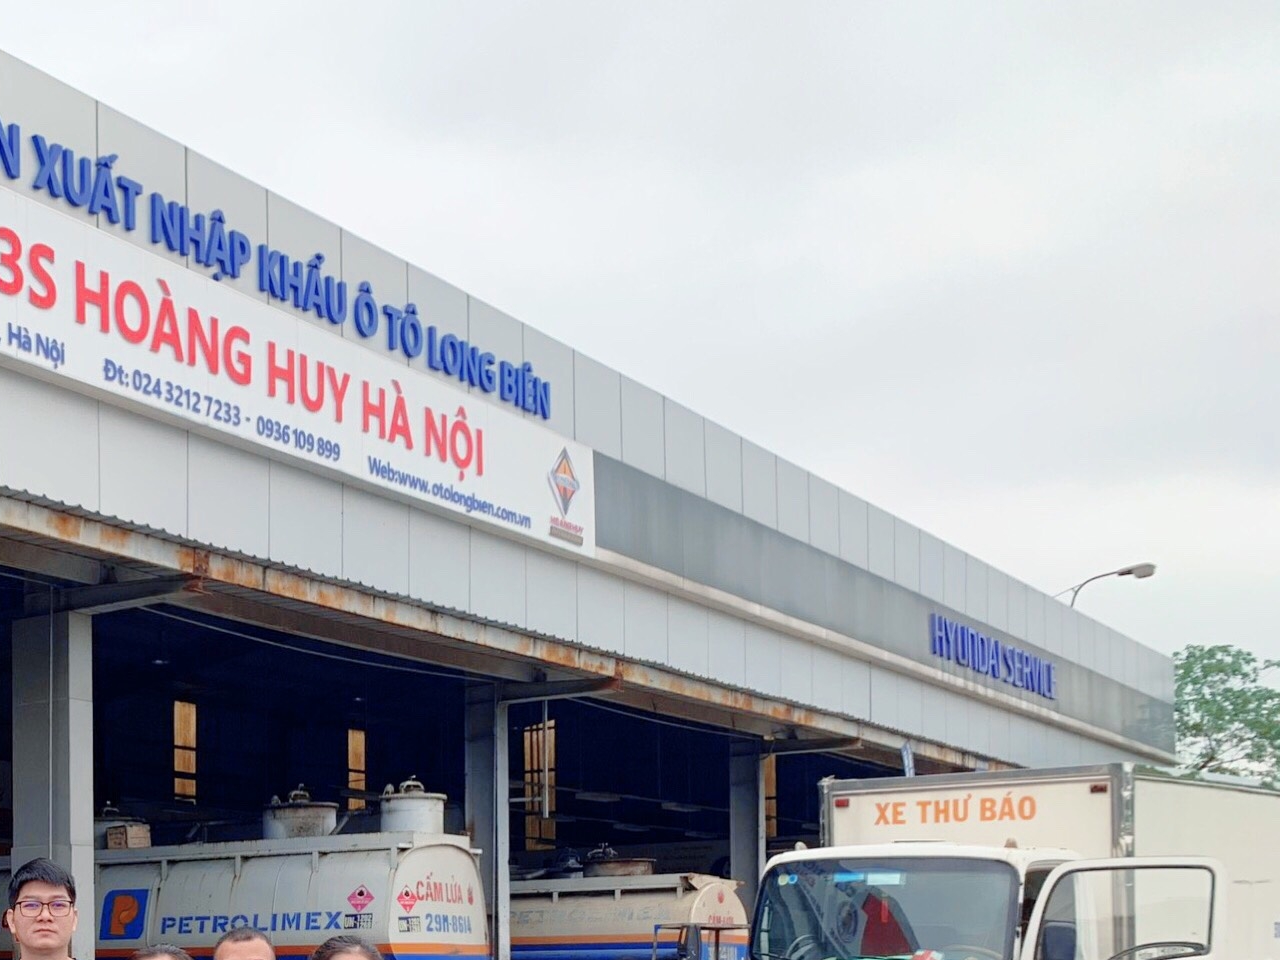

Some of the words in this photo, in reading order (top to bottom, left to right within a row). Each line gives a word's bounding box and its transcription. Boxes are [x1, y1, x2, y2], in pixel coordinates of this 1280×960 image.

[31, 134, 143, 231] XUẤT
[150, 192, 251, 281] NHẬP
[258, 244, 347, 325] KHẨU
[354, 281, 378, 338] Ô
[383, 303, 423, 359] TÔ
[428, 325, 496, 393] LONG
[500, 360, 550, 420] BIÊN
[8, 322, 32, 354] Hà
[36, 333, 65, 369] Nội
[74, 260, 253, 386] HOÀNG
[267, 341, 350, 423] HUY
[362, 379, 413, 450] HÀ
[424, 406, 484, 480] NỘI
[103, 358, 130, 388] Đt:
[132, 369, 162, 399] 024
[165, 381, 201, 414] 3212
[204, 396, 241, 426] 7233
[256, 416, 291, 445] 0936
[293, 428, 314, 452] 109
[316, 437, 341, 462] 899
[874, 802, 906, 825] XE
[916, 793, 972, 824] THƯ
[979, 791, 1037, 822] BÁO
[160, 911, 343, 935] PETROLIMEX
[425, 912, 472, 934] 29M-8614
